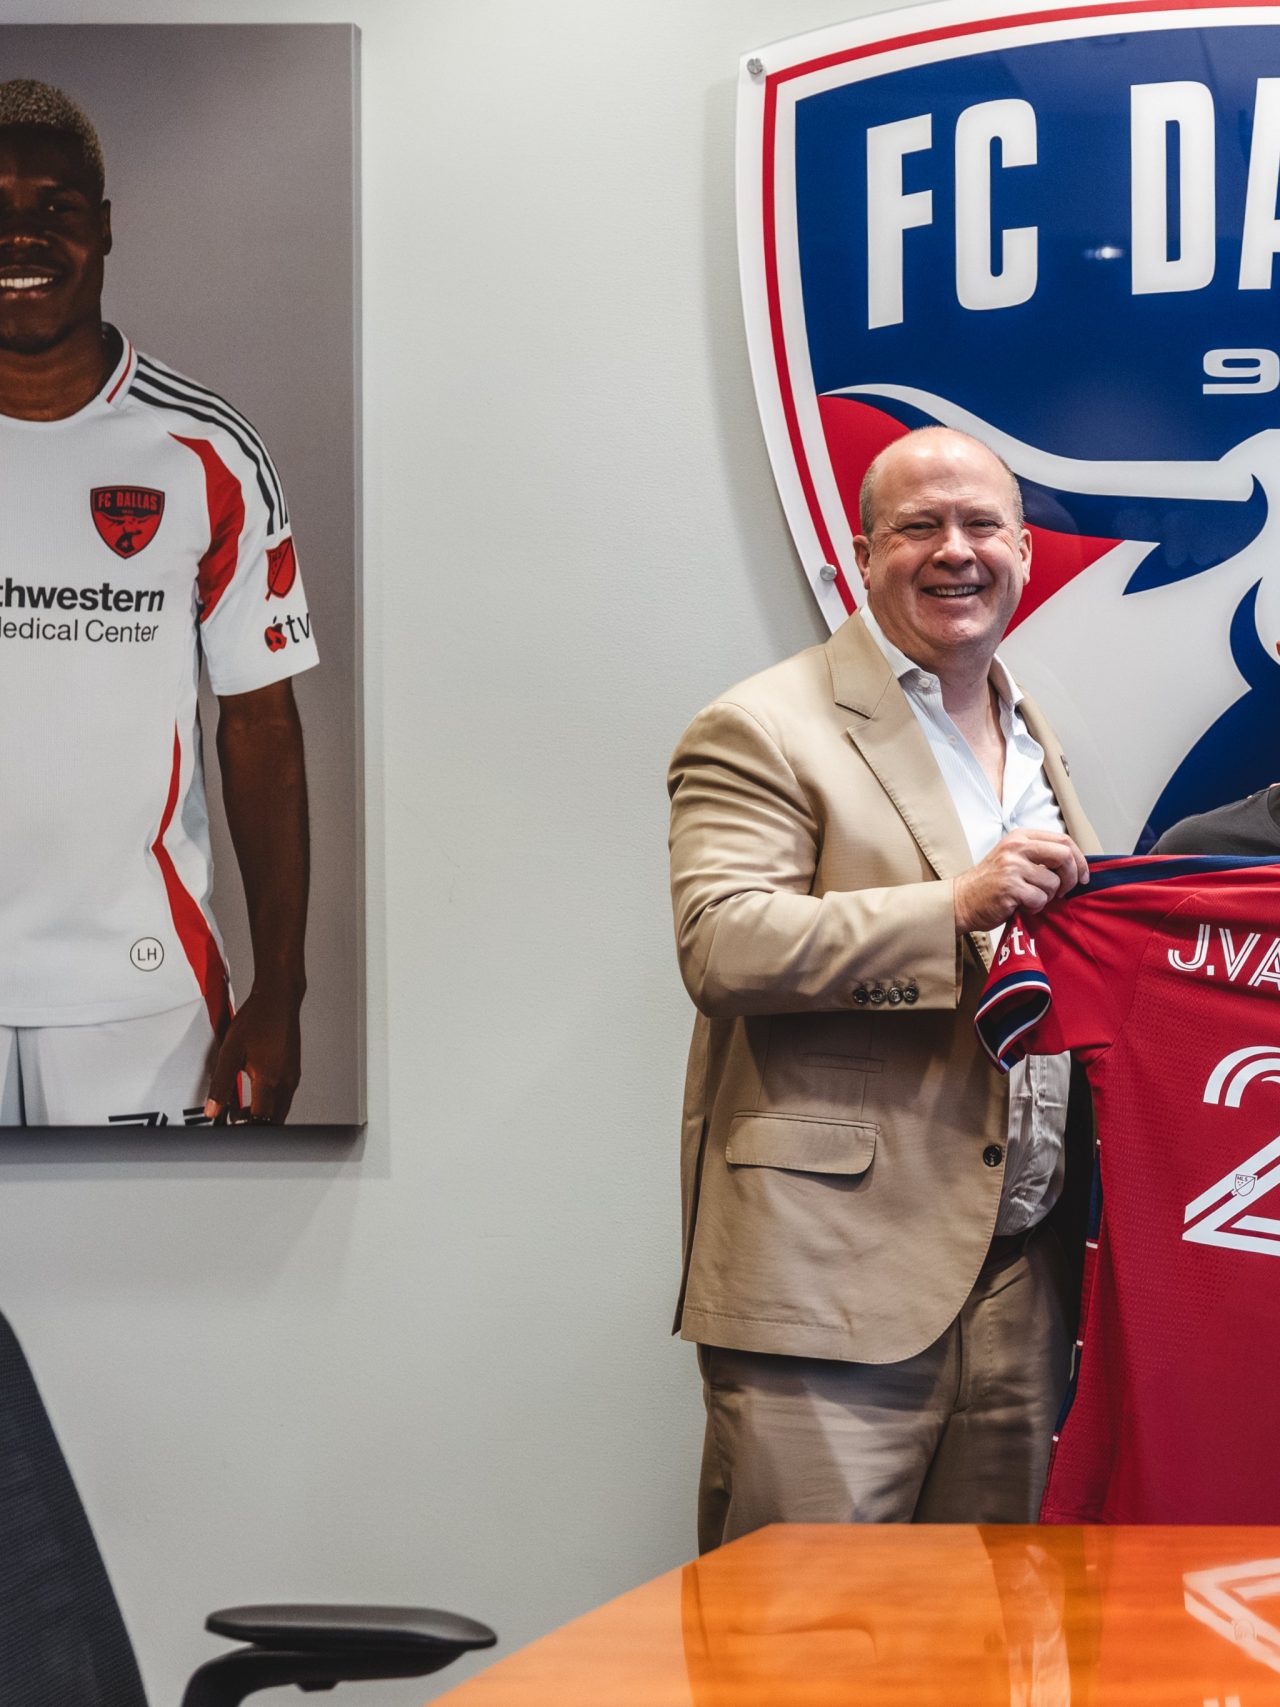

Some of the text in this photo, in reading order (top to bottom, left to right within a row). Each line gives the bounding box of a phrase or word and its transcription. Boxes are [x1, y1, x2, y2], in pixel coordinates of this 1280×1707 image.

[866, 98, 1039, 330] FC
[98, 491, 158, 511] FC DALLAS
[0, 616, 159, 642] edical Center
[137, 947, 157, 961] LH
